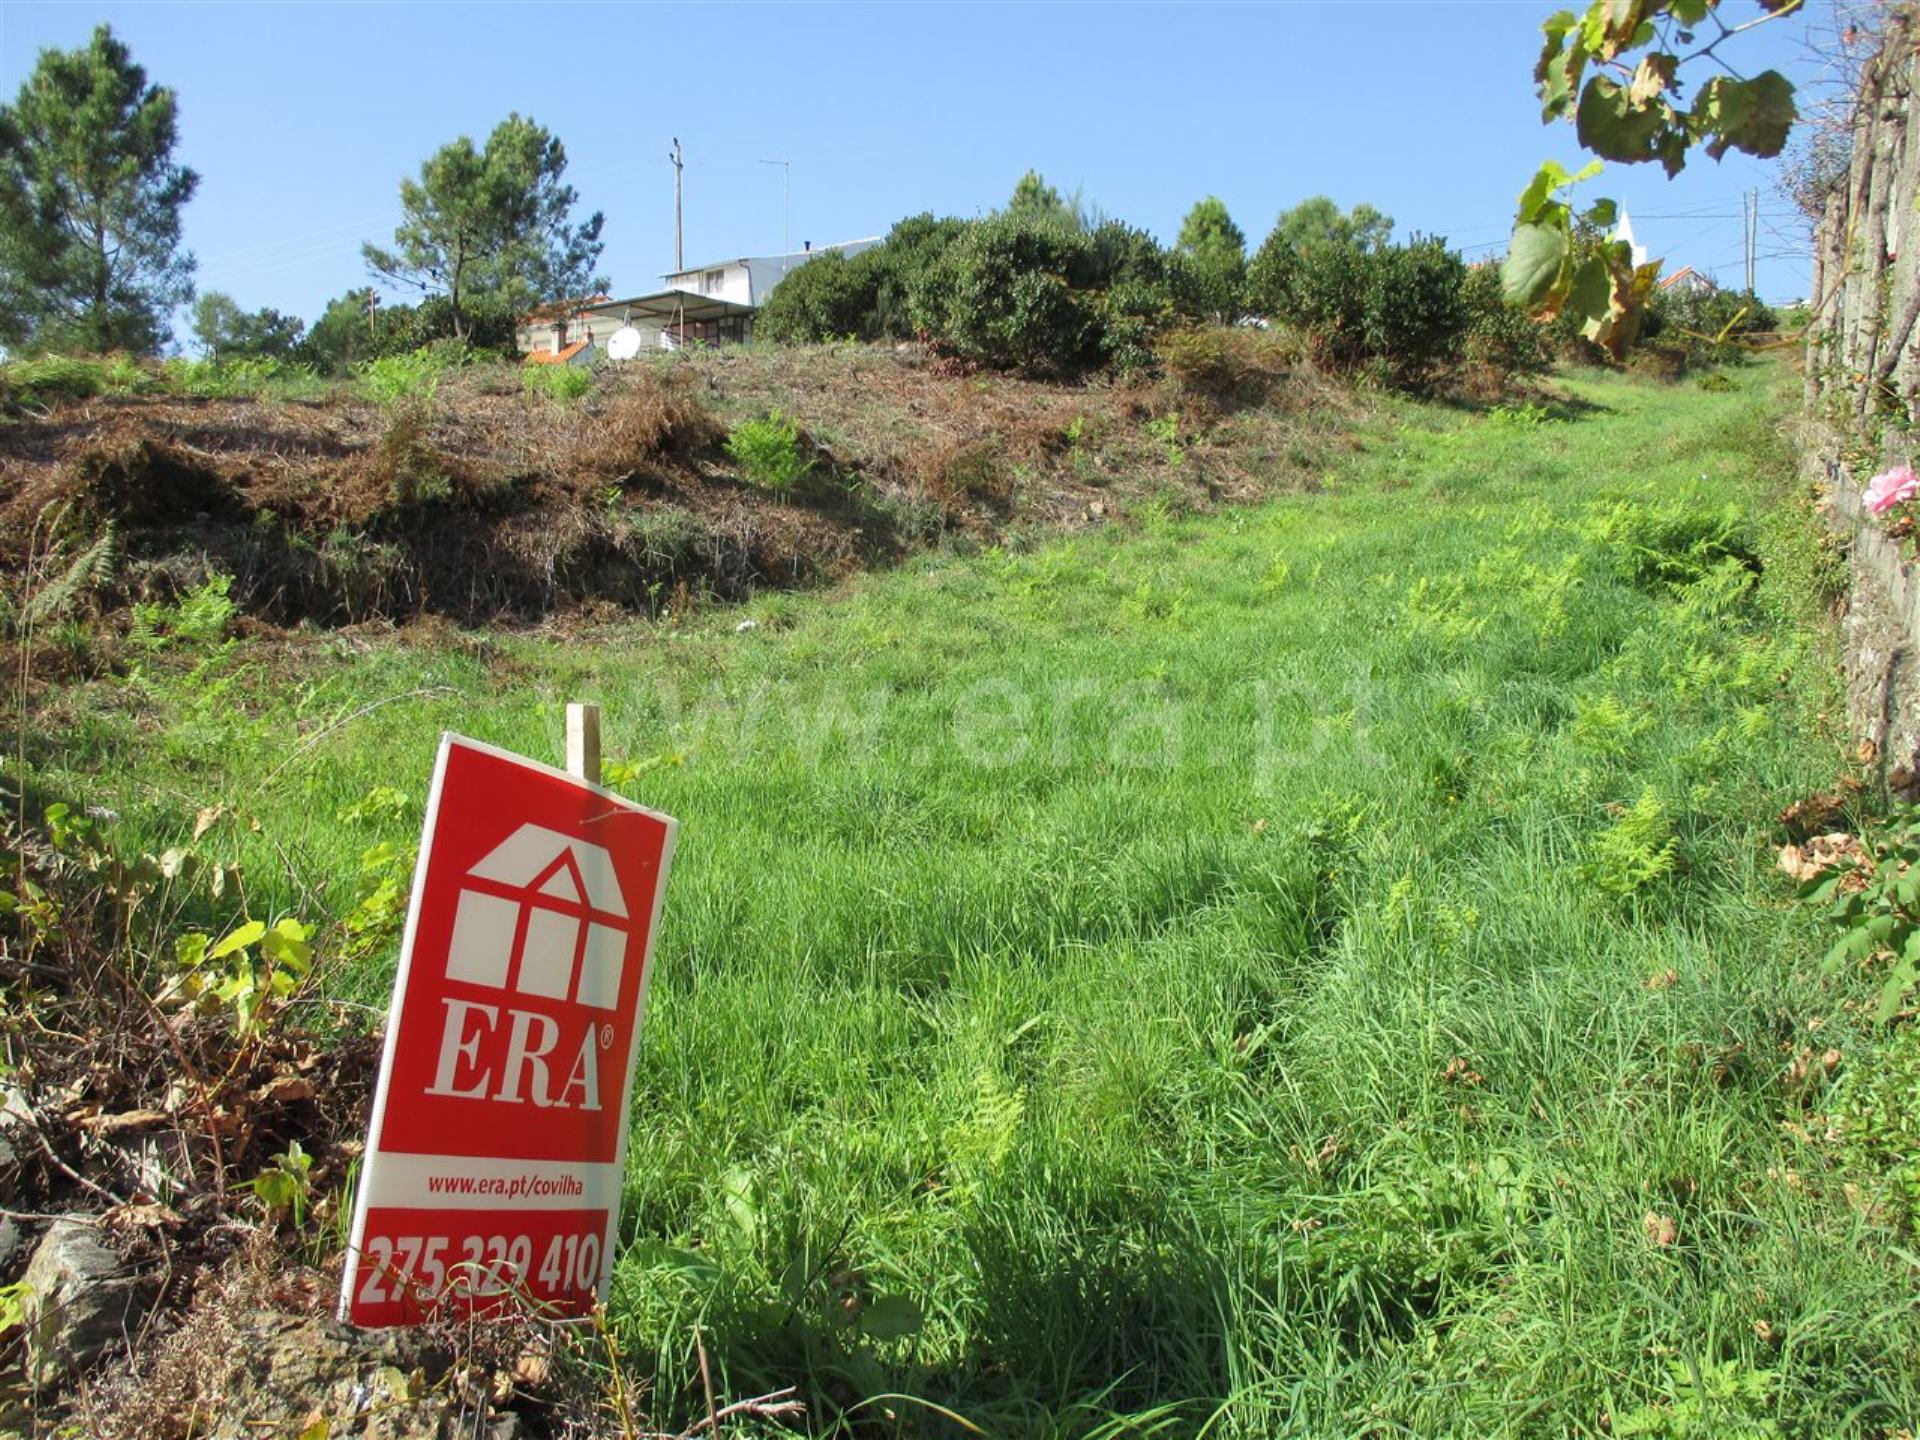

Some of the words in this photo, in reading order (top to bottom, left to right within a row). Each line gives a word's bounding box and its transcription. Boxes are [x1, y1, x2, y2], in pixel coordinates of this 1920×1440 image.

[429, 1174, 583, 1199] www.era.pt/covilha
[359, 1236, 449, 1304] 275
[454, 1233, 532, 1299] 329
[538, 1232, 600, 1293] 410
